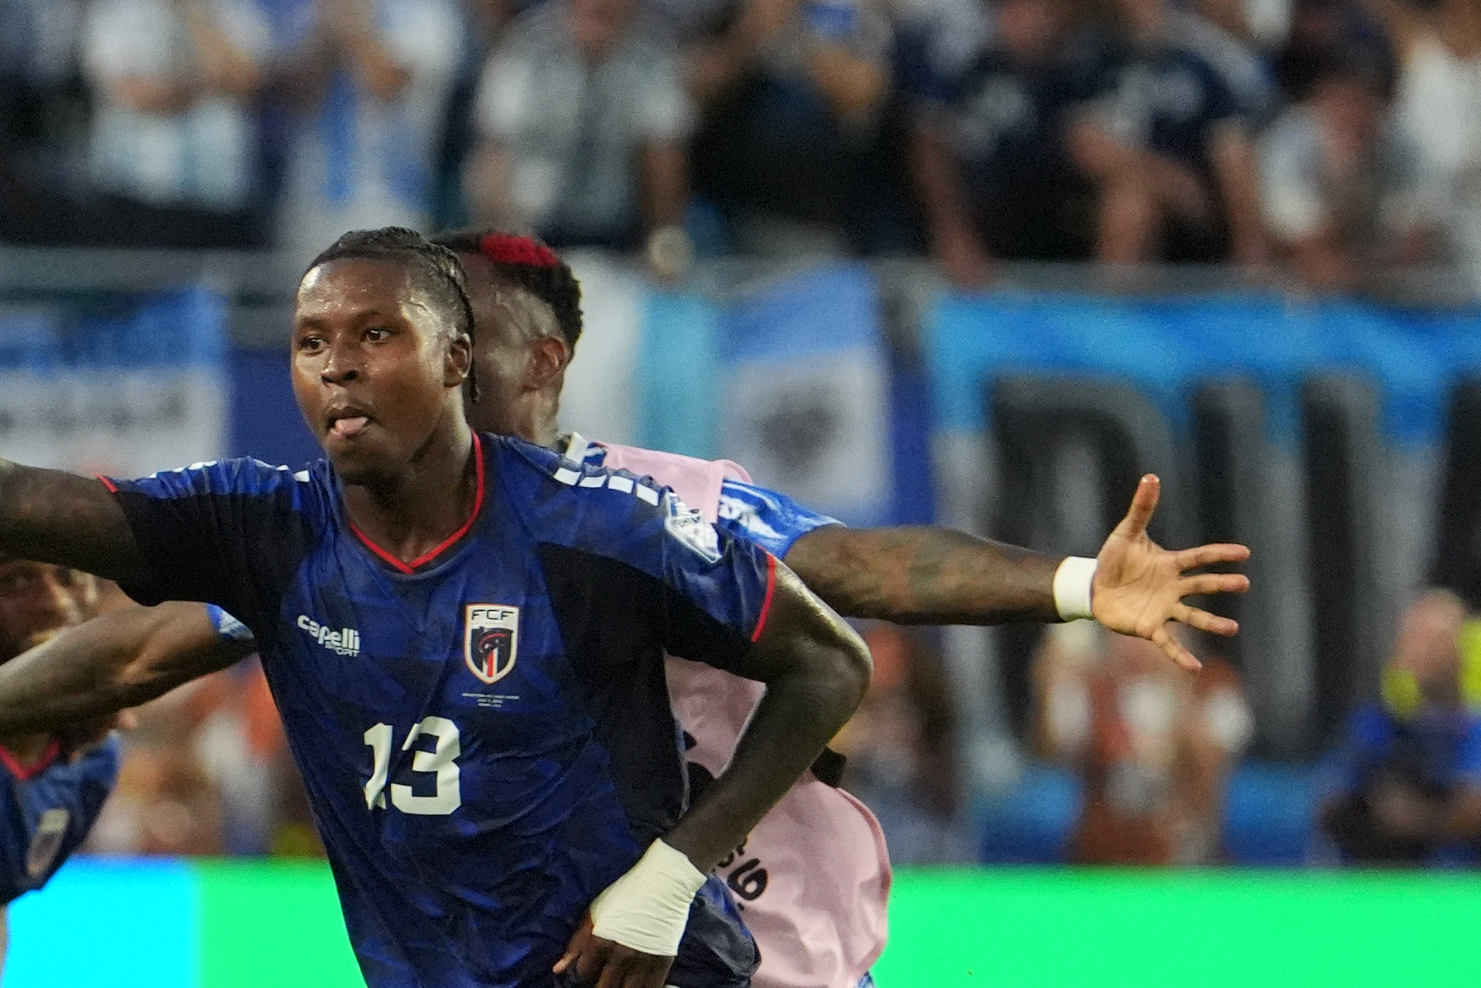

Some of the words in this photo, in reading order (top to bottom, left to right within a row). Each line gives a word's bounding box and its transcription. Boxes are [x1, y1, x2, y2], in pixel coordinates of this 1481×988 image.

[296, 614, 361, 650] capelli
[471, 608, 515, 621] FCF
[363, 715, 462, 816] 13
